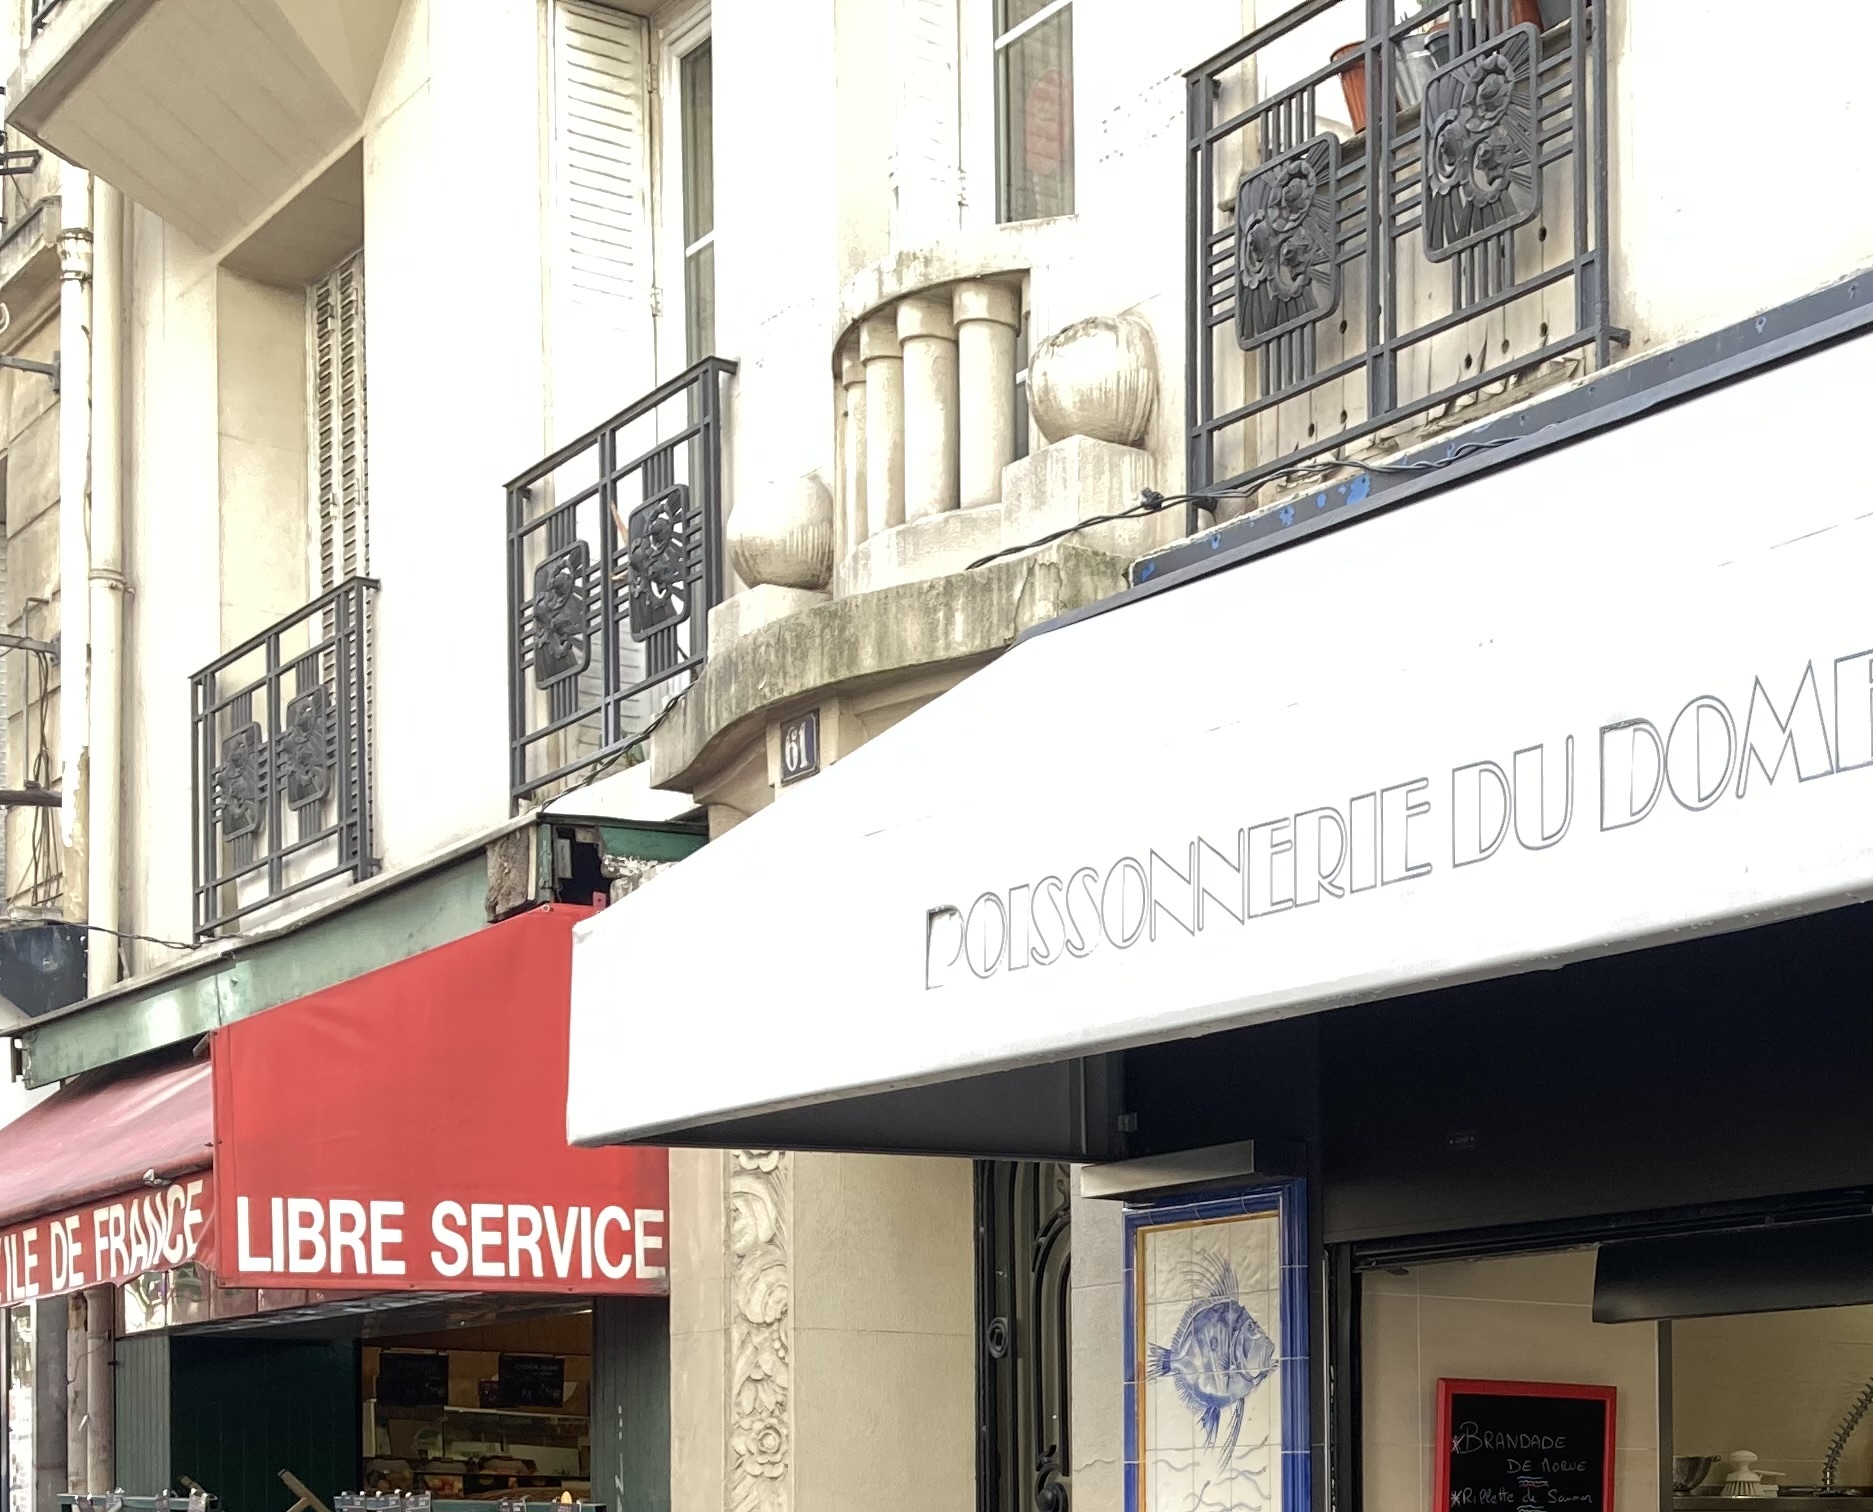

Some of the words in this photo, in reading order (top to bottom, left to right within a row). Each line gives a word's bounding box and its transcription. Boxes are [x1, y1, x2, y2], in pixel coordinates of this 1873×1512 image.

[784, 721, 808, 772] 61
[925, 776, 1433, 992] POISSONNERIE
[1452, 734, 1574, 869] DU
[50, 1214, 84, 1292] DE
[93, 1179, 204, 1282] FRANCE
[236, 1196, 406, 1276] LIBRE
[430, 1199, 667, 1280] SERVICE
[1506, 1458, 1533, 1474] DE
